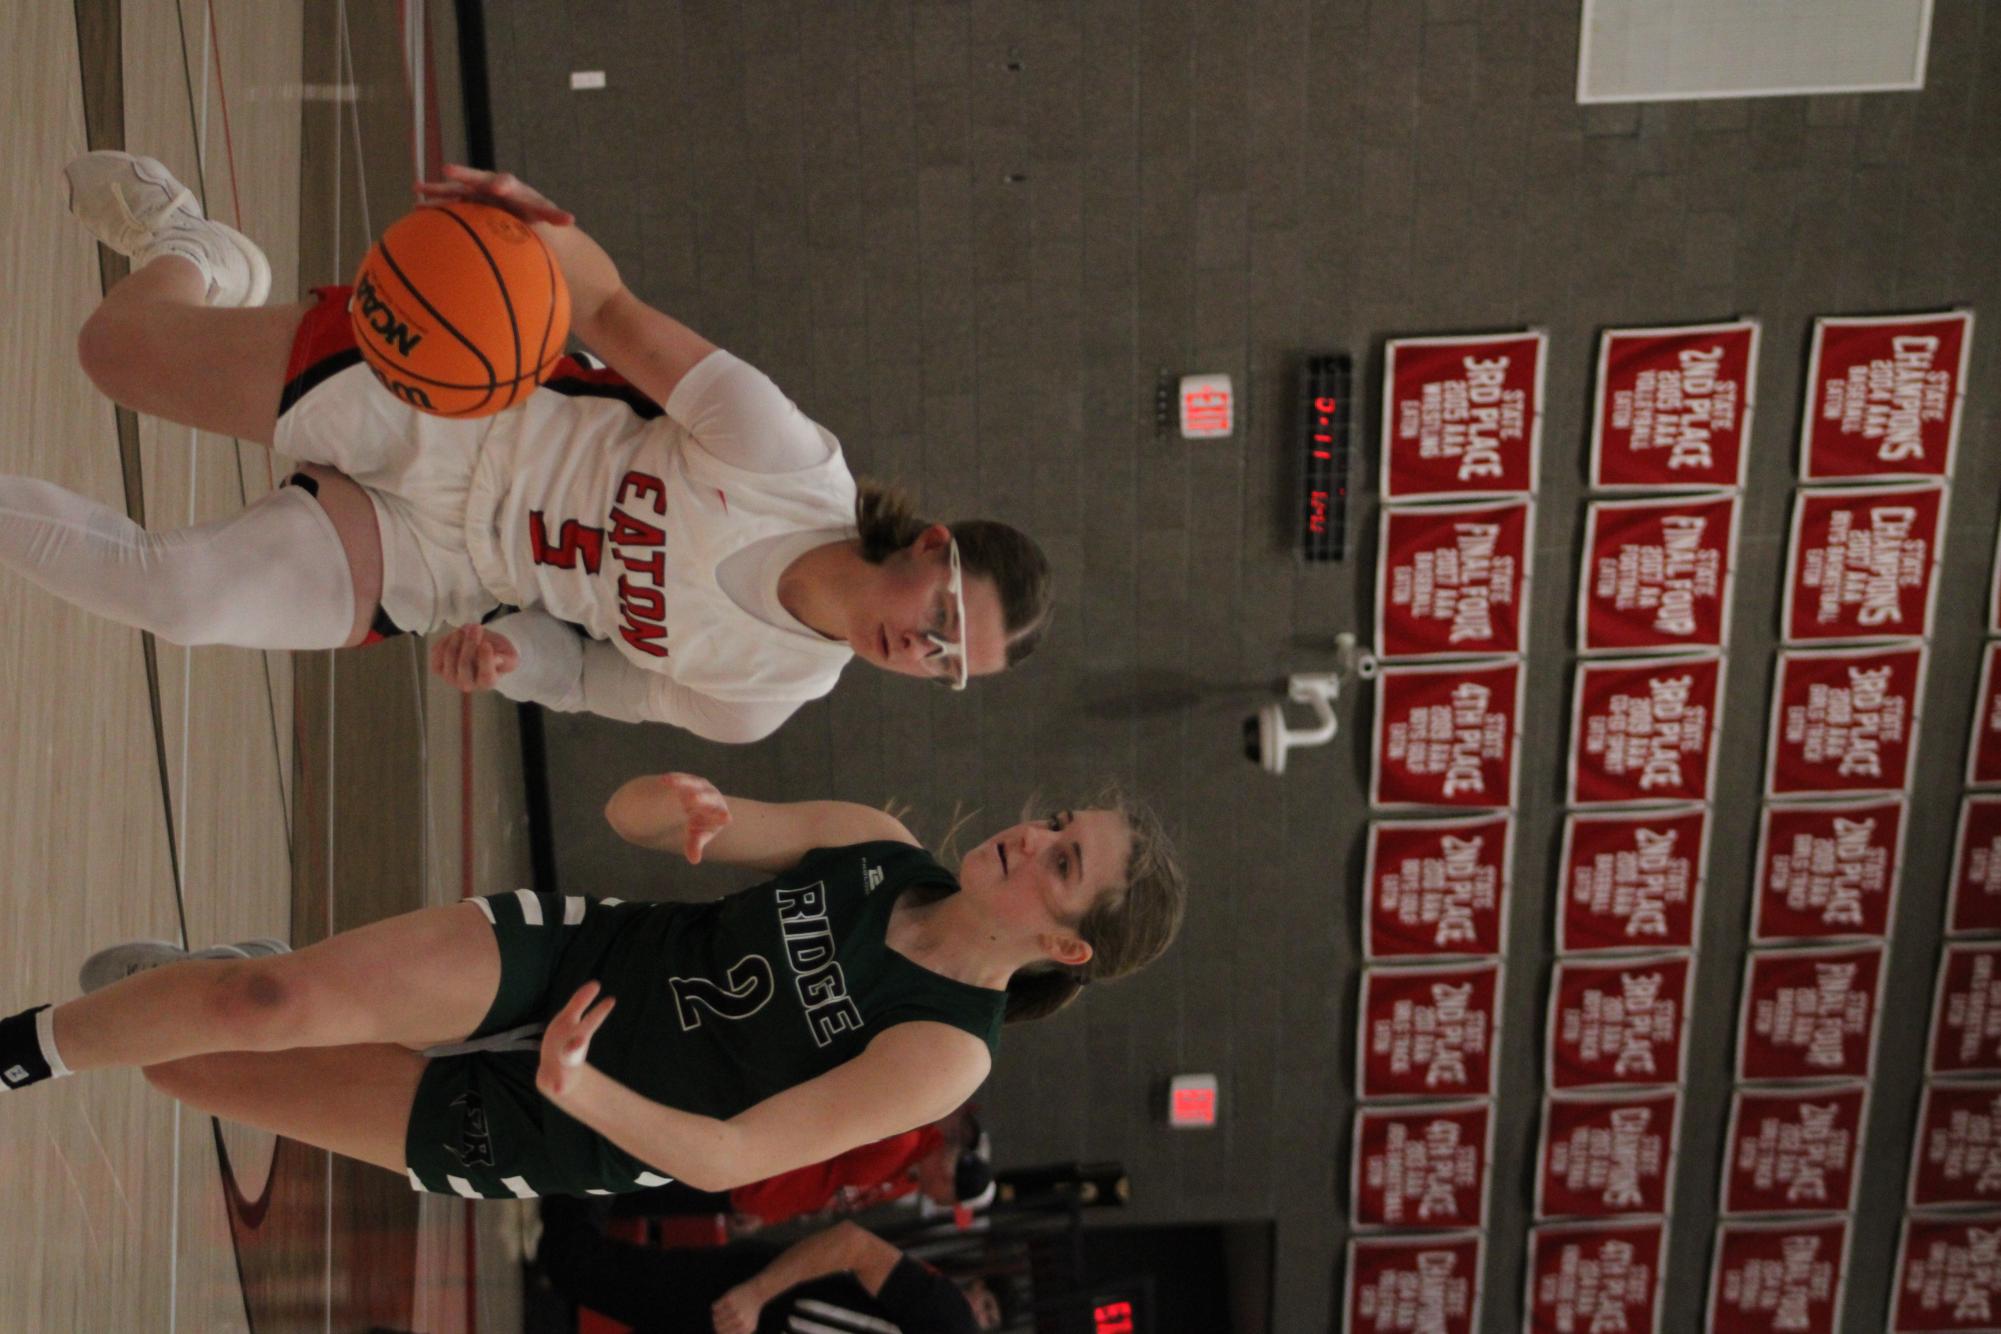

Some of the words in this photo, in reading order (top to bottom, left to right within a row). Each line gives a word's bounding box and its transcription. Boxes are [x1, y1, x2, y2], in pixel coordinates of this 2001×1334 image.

[1464, 358, 1509, 402] 3RD
[1680, 348, 1722, 394] 2ND
[1185, 392, 1229, 430] EXIT
[1502, 390, 1524, 440] STATE
[1613, 392, 1631, 428] EATON
[1630, 371, 1654, 450] VOLLEYBALL
[1712, 382, 1735, 430] STATE
[1824, 380, 1844, 420] EATON
[1842, 367, 1866, 433] BASEBALL
[1878, 337, 1938, 460] CHAMPIONS
[1923, 372, 1948, 421] STATE
[1401, 402, 1418, 438] EATON
[1420, 383, 1440, 458] WRESTLING
[1442, 425, 1464, 457] AAA
[1654, 415, 1676, 446] AAA
[1668, 400, 1712, 468] PLACE
[1864, 405, 1886, 438] AAA
[1458, 409, 1502, 480] PLACE
[529, 510, 605, 576] 5
[1662, 518, 1706, 576] FINAL
[1830, 511, 1850, 542] BOYS
[608, 470, 669, 658] EATON
[1454, 524, 1498, 582] FINAL
[1696, 550, 1718, 596] STATE
[1804, 551, 1822, 586] EATON
[1858, 508, 1914, 626] CHAMPIONS
[1902, 540, 1924, 587] STATE
[1393, 567, 1410, 604] EATON
[1412, 554, 1433, 616] BASEBALL
[1490, 557, 1512, 604] STATE
[1598, 559, 1615, 596] EATON
[1616, 546, 1638, 610] FOOTBALL
[1638, 588, 1658, 608] AA
[1818, 547, 1846, 623] BASKETBALL
[1844, 572, 1864, 604] AAA
[1434, 590, 1454, 619] AAA
[1450, 587, 1490, 644] FOUR
[1654, 580, 1694, 634] FOUR
[1452, 684, 1489, 726] 4TH
[1650, 676, 1692, 718] 3RD
[1849, 666, 1892, 708] 3RD
[1483, 714, 1504, 759] STATE
[1682, 707, 1704, 750] STATE
[1786, 707, 1804, 742] EATON
[1880, 697, 1902, 742] STATE
[1444, 730, 1482, 797] PLACE
[1627, 738, 1647, 768] AAA
[1640, 723, 1680, 790] PLACE
[1839, 714, 1880, 777] PLACE
[1442, 836, 1482, 877] 2ND
[1635, 829, 1676, 869] 2ND
[1834, 818, 1874, 858] 2ND
[1474, 866, 1494, 909] STATE
[1666, 858, 1688, 901] STATE
[1864, 848, 1885, 890] STATE
[1436, 882, 1474, 946] PLACE
[1626, 876, 1666, 936] PLACE
[1822, 864, 1862, 924] PLACE
[776, 880, 864, 1048] RIDGE
[669, 954, 774, 1031] 2
[1432, 983, 1472, 1022] 2ND
[1620, 974, 1662, 1011] 3RD
[1815, 964, 1854, 1014] FINAL
[1464, 1011, 1484, 1054] STATE
[1615, 1016, 1654, 1075] PLACE
[1807, 1019, 1842, 1066] FOUR
[1426, 1027, 1466, 1088] PLACE
[1426, 1121, 1460, 1155] 4TH
[1800, 1104, 1837, 1138] 2ND
[1604, 1108, 1650, 1206] CHAMPIONS
[1788, 1144, 1826, 1200] PLACE
[1420, 1160, 1456, 1218] PLACE
[1600, 1241, 1632, 1274] 4TH
[1782, 1236, 1818, 1282] FINAL
[1968, 1229, 1994, 1264] 2ND
[1414, 1252, 1454, 1334] CHAMPION
[1590, 1280, 1625, 1334] PLACE
[1773, 1286, 1808, 1328] FOUR
[1954, 1267, 1990, 1322] PLACE
